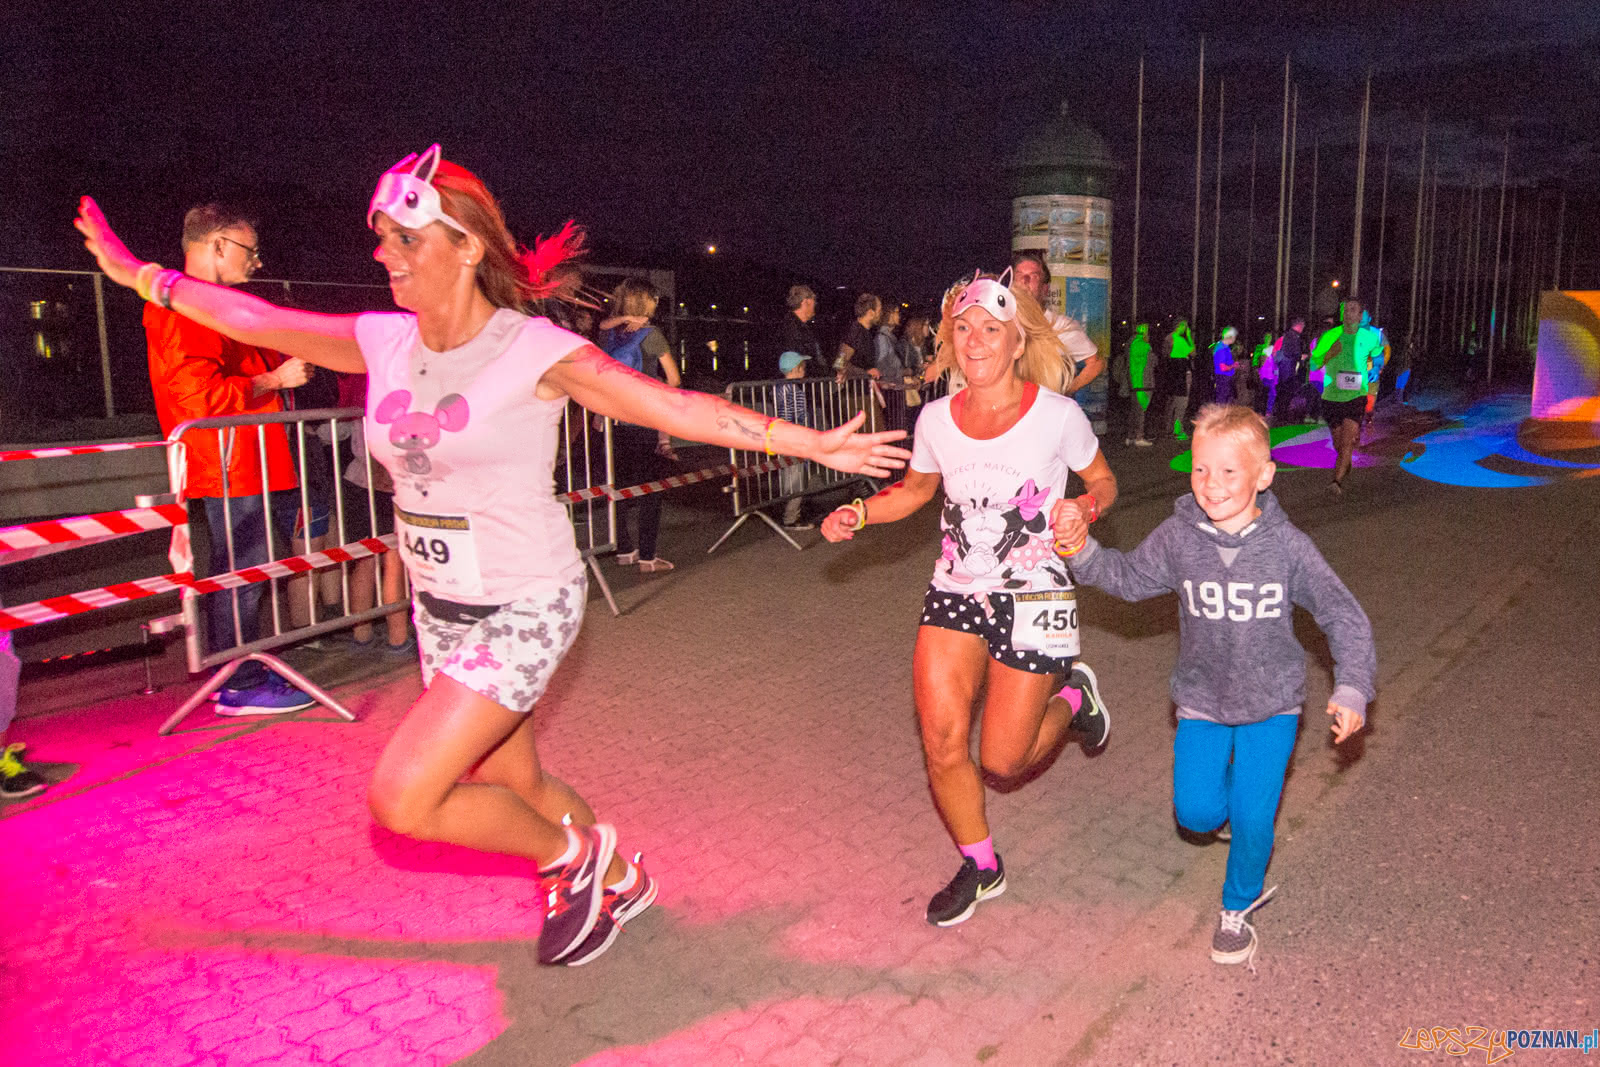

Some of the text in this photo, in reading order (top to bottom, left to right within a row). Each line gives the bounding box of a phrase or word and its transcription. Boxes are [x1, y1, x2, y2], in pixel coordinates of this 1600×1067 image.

[1344, 375, 1356, 384] 94
[983, 462, 1021, 478] MATCH
[1182, 579, 1284, 622] 1952
[1032, 607, 1078, 632] 450
